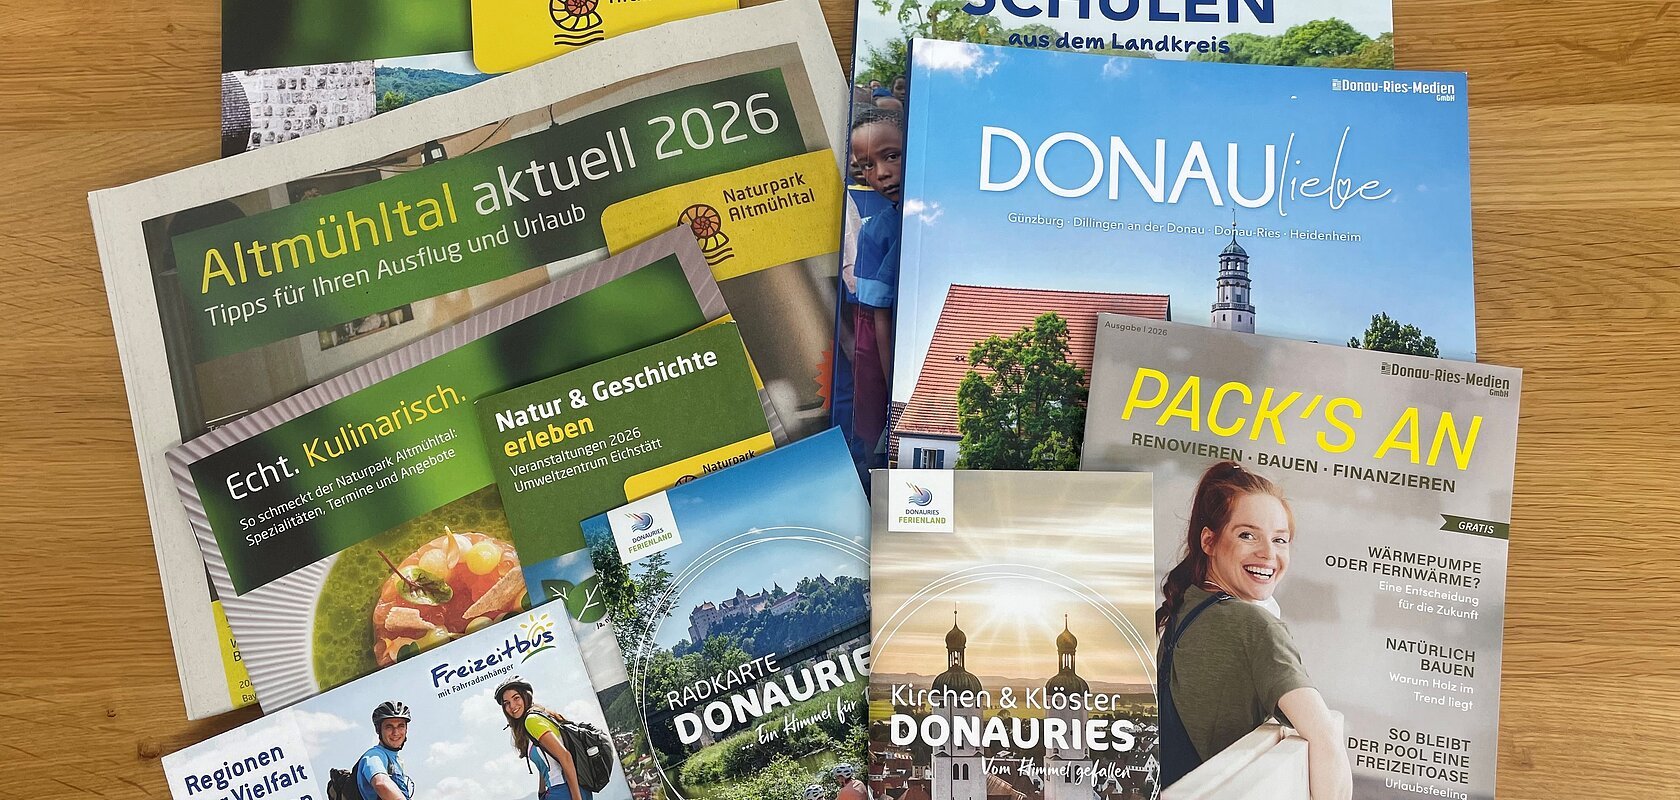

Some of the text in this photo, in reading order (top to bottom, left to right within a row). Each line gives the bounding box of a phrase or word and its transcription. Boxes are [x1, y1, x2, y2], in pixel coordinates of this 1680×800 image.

[1008, 32, 1231, 54] aus dem Landkreis
[1342, 79, 1455, 95] Donau-Ries-Medien
[1436, 94, 1455, 102] GmbH
[201, 92, 780, 294] Altmühltal aktuell 2026
[722, 172, 806, 204] Naturpark
[729, 188, 815, 222] Altmühltal
[1008, 212, 1362, 242] Günzburg Dillingen an der Donau Donau-Ries Heidenheim
[204, 204, 586, 327] Tipps für Ihren Ausflug und Urlaub
[1105, 321, 1141, 332] Ausgabe
[1148, 327, 1168, 336] 2026
[495, 350, 718, 433] Natur & Geschichte
[1390, 364, 1510, 391] Donau-Ries-Medien
[1489, 388, 1510, 398] GmbH
[226, 385, 466, 500] Echt. Kulinarisch.
[503, 414, 595, 458] erleben
[1374, 406, 1483, 471] AN
[509, 427, 642, 477] Veranstaltungen 2026
[514, 438, 663, 494] Umweltzentrum Eichstätt
[1131, 432, 1456, 494] RENOVIEREN BAUEN FINANZIEREN
[239, 428, 458, 531] So schmeckt der Naturpark Altmühltal:
[245, 447, 456, 547] Spezialitäten, Termine und Angebote
[632, 528, 664, 544] DONAURIES
[898, 517, 946, 525] FERIENLAND
[1458, 521, 1494, 534] GRATIS
[628, 532, 673, 554] FERIENLAND
[1325, 555, 1481, 589] ODER FERNWÄRME?
[1368, 545, 1482, 574] WÄRMEPUMPE
[1379, 580, 1480, 606] Eine Entscheidung
[1398, 599, 1479, 620] für die Zukunft
[430, 631, 555, 688] Freizeitbus
[1386, 638, 1476, 662] NATÜRLICH
[437, 663, 515, 699] mit Fahrradanhänger
[666, 652, 781, 711] RADKARTE
[1389, 672, 1474, 694] Warum Holz im
[1420, 660, 1475, 678] BAUEN
[673, 645, 870, 745] DONAURIE
[891, 684, 991, 709] Kirchen
[998, 686, 1017, 709] &
[1025, 686, 1120, 711] Klöster
[1414, 691, 1473, 711] Trend liegt
[756, 724, 779, 745] Ein
[784, 707, 832, 736] Himmel
[837, 696, 857, 725] für
[890, 714, 1135, 752] DONAURIES
[1348, 737, 1470, 768] DER POOL EINE
[1389, 728, 1471, 752] SO BLEIBT
[184, 746, 285, 796] Regionen
[230, 764, 308, 800] Vielfalt
[981, 756, 1131, 787] Vom Himmel gefallen
[1356, 754, 1469, 784] FREIZEITOASE
[1385, 778, 1468, 800] Urlaubsfeeling
